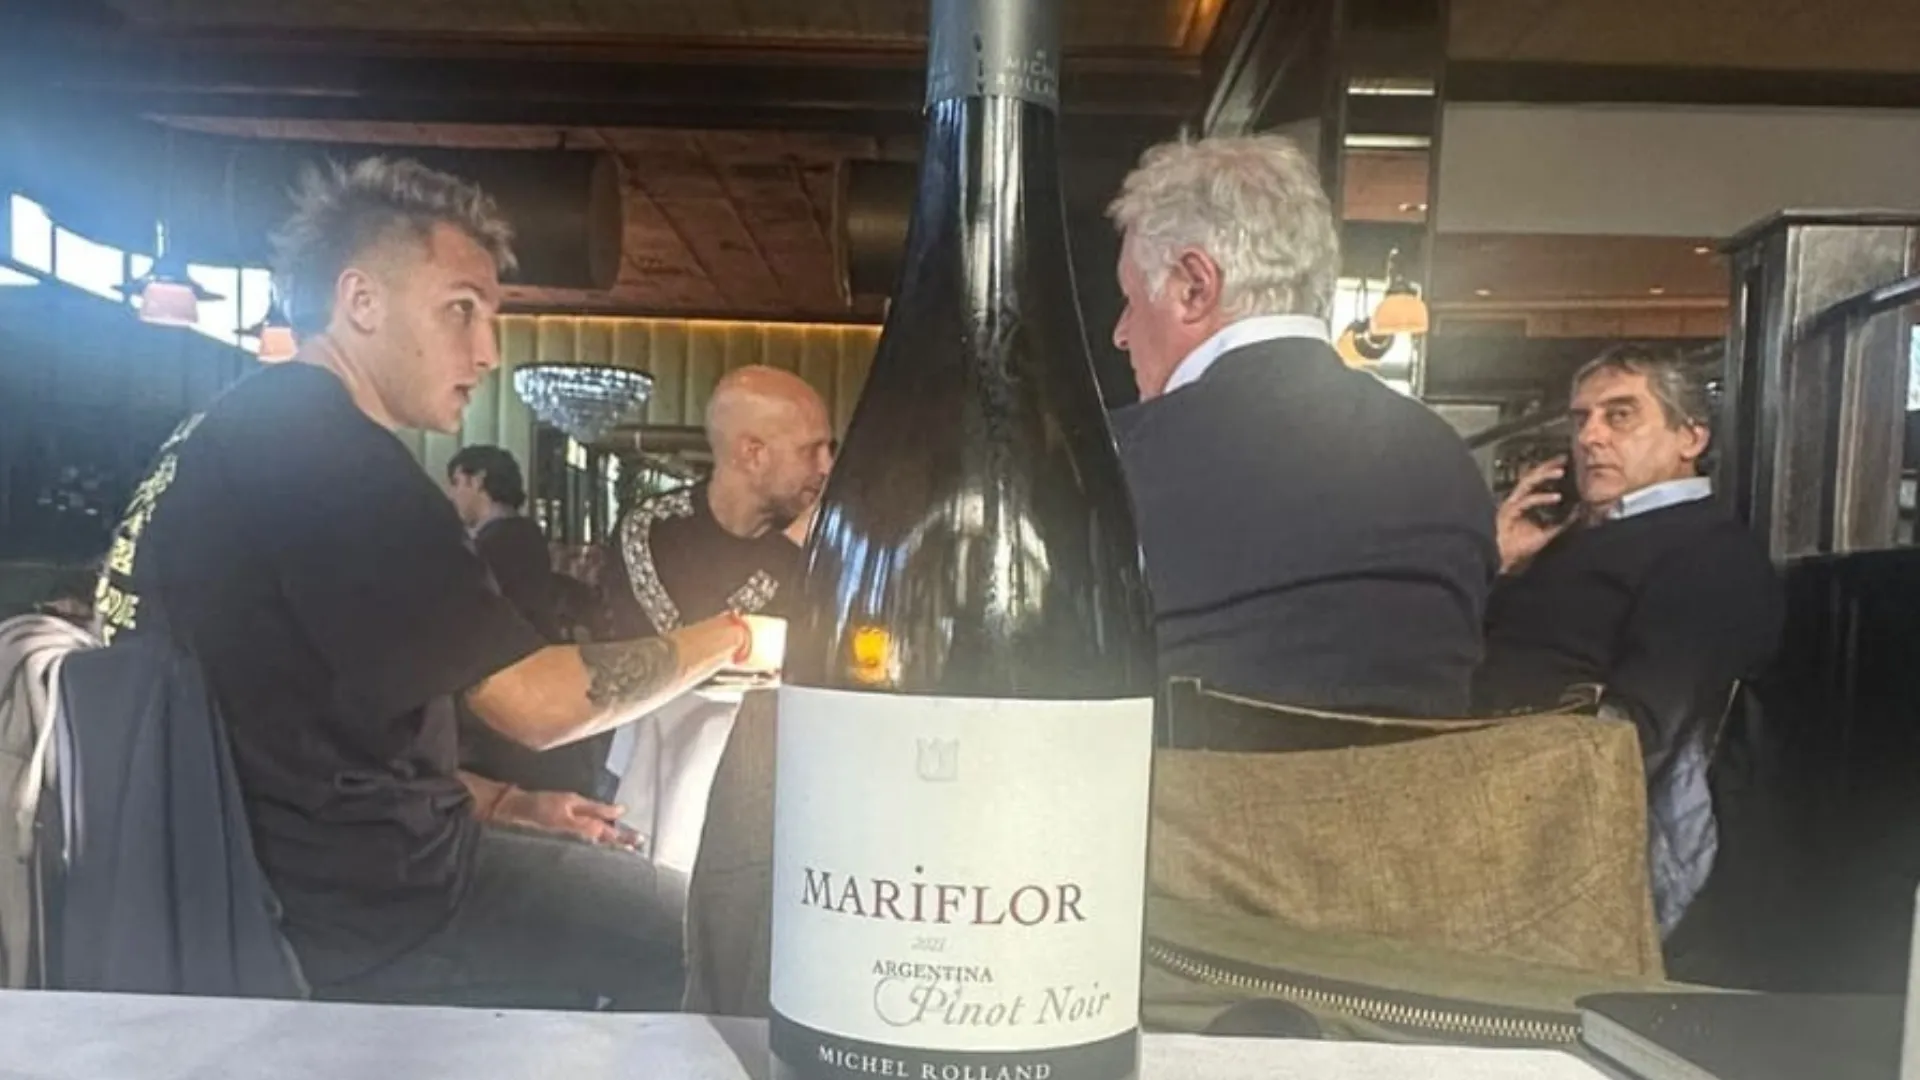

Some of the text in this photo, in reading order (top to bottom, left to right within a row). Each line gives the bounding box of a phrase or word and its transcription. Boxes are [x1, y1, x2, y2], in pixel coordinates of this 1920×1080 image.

[872, 959, 994, 984] ARGENTINA
[873, 974, 1111, 1028] Pinot Noir
[817, 1043, 1052, 1080] MICHEL ROLLAND
